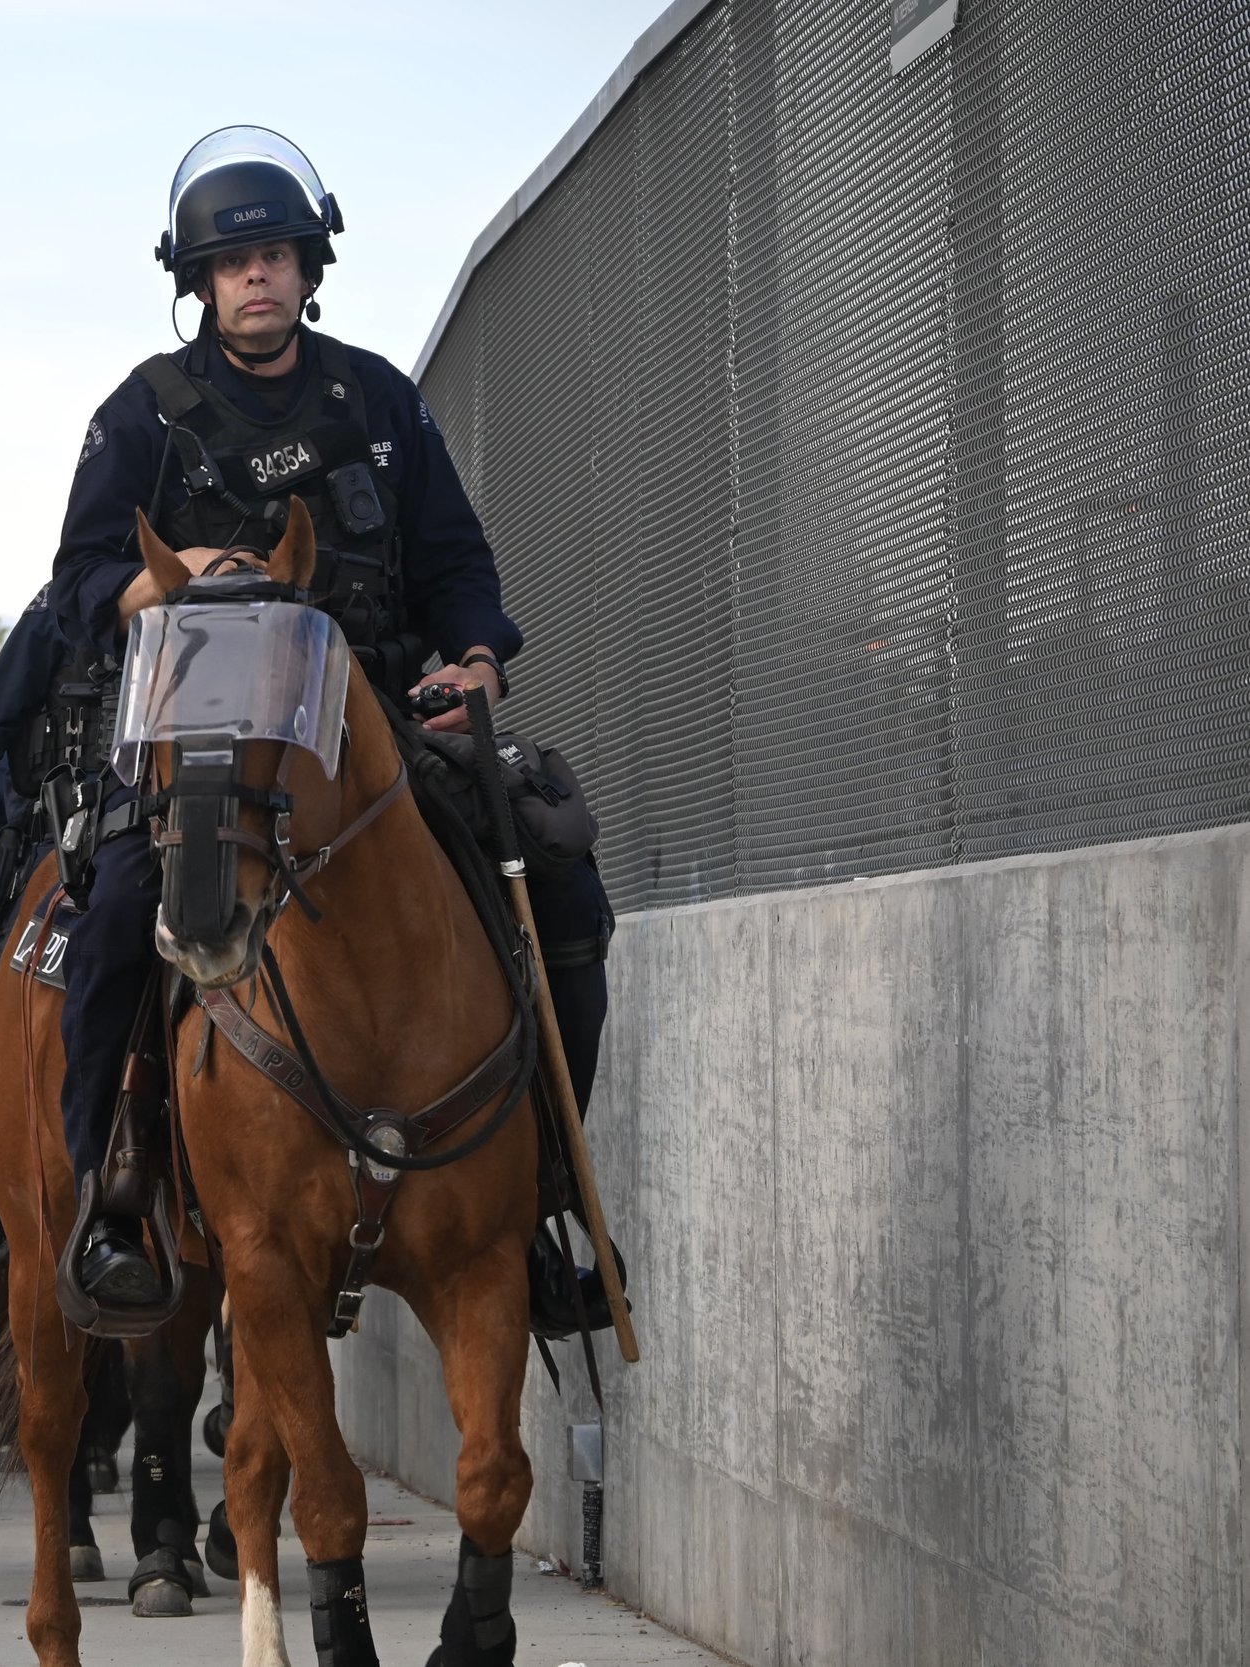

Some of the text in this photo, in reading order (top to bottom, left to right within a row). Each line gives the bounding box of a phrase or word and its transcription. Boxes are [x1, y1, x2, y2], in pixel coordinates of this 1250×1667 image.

[233, 207, 267, 223] OLMOS
[251, 442, 310, 483] 34354
[231, 1019, 305, 1090] LAPD
